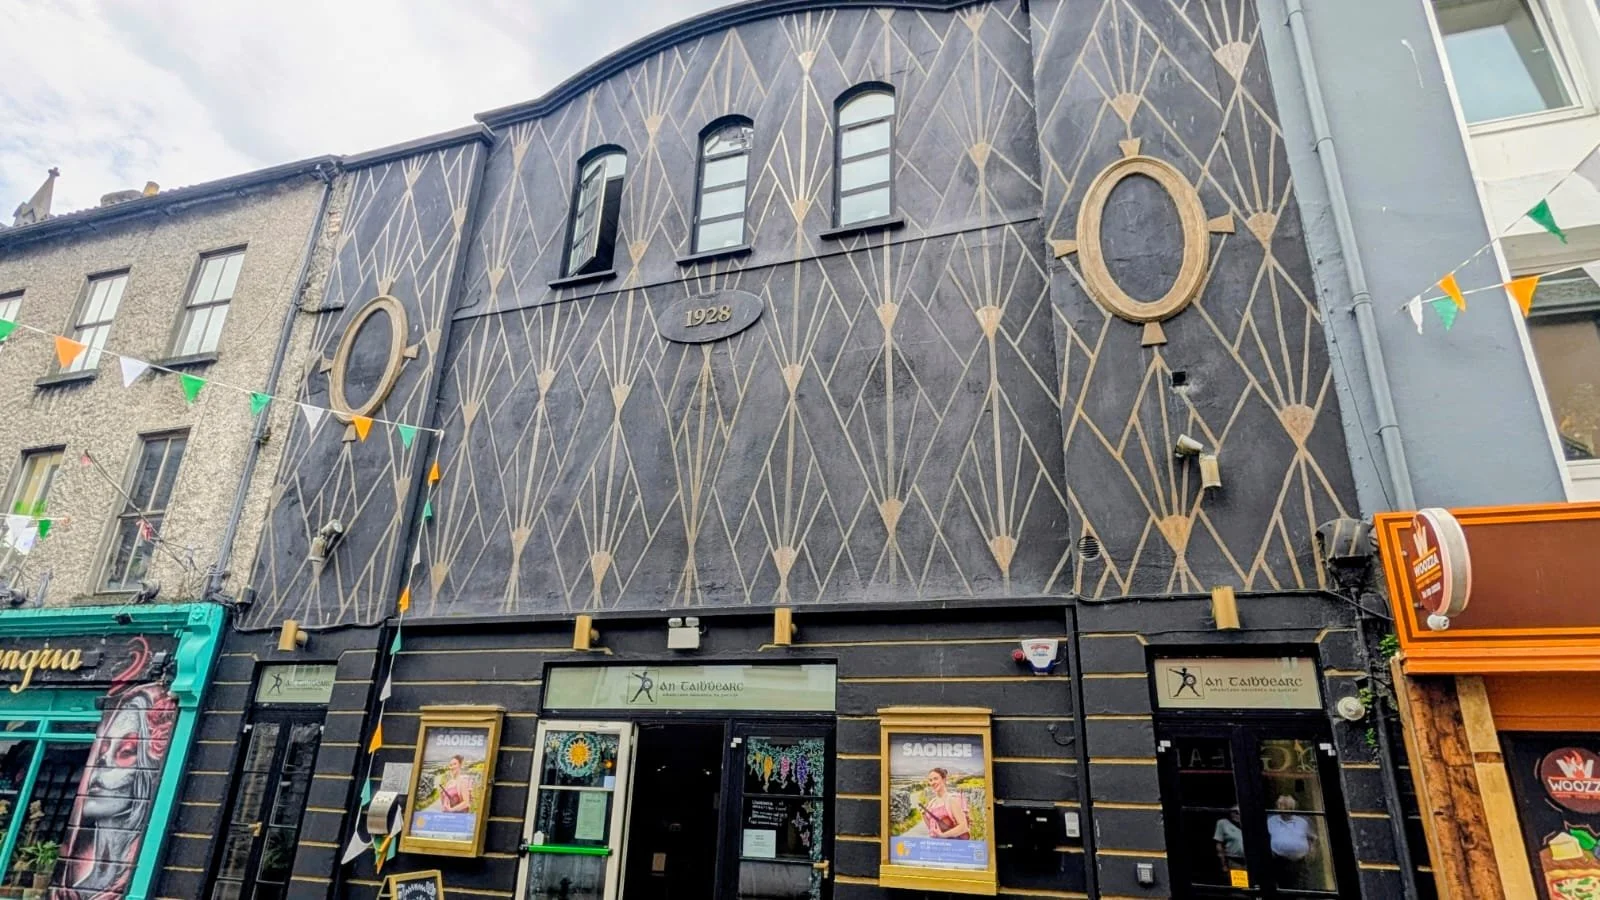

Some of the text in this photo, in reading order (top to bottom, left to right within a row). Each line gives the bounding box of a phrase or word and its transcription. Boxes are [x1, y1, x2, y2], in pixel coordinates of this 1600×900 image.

[685, 305, 732, 328] 1928
[1413, 552, 1440, 578] WOOZZA
[0, 649, 83, 693] ngria
[436, 734, 484, 746] SAOIRSE
[902, 742, 972, 757] SAOIRSE
